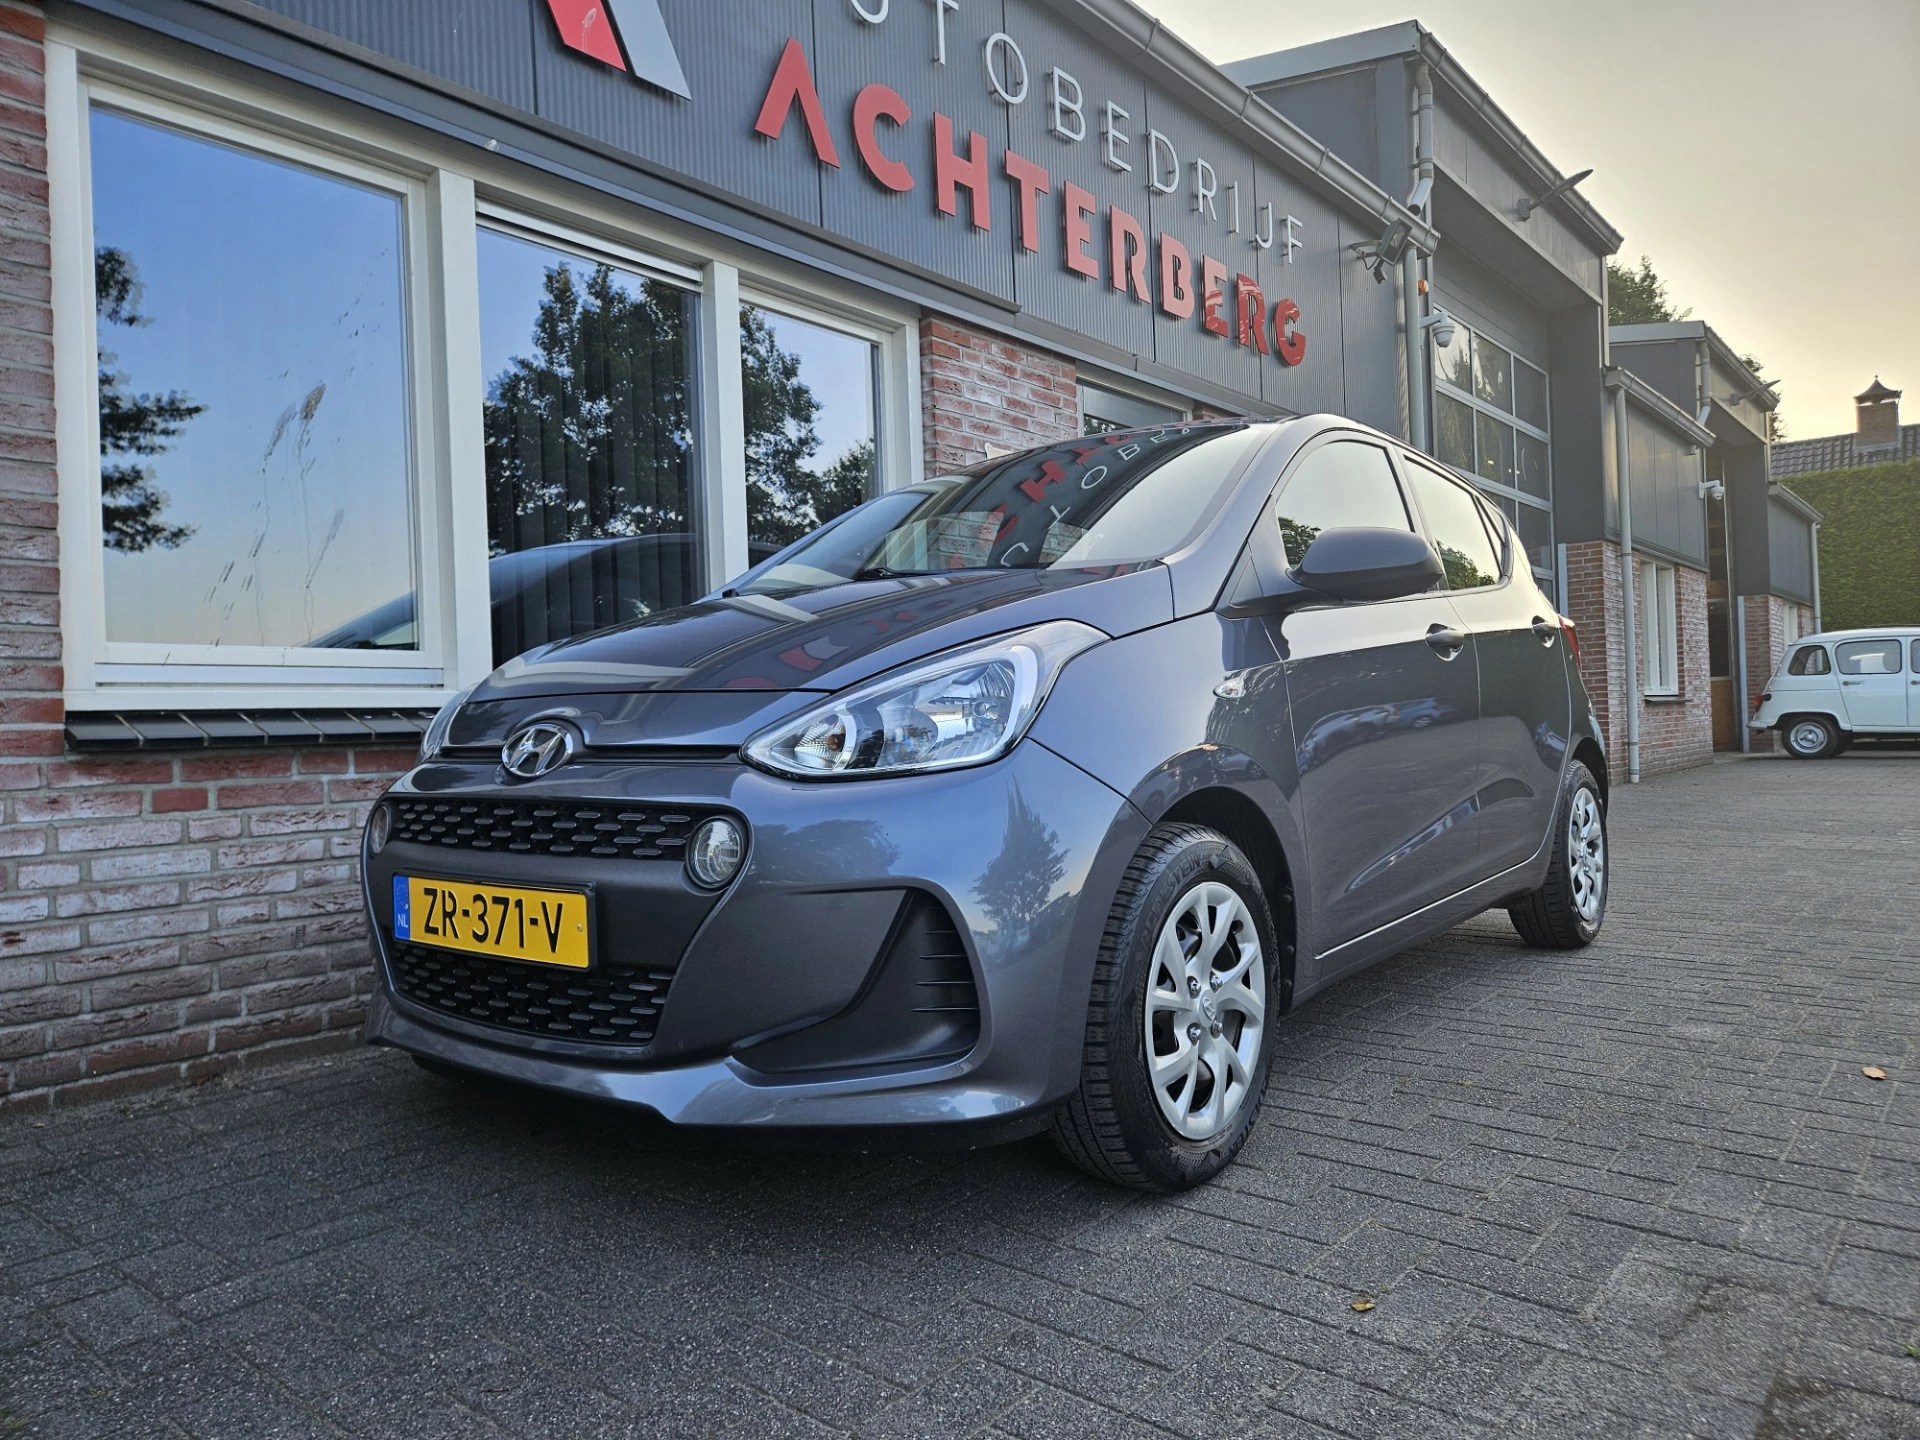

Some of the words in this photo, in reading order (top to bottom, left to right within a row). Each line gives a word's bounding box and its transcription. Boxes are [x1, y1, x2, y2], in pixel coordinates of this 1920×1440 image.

[755, 37, 1306, 367] ACHTERBERG
[851, 0, 1304, 265] TOBEDRIJF
[397, 912, 409, 928] NL
[423, 887, 563, 953] ZR-371-V
